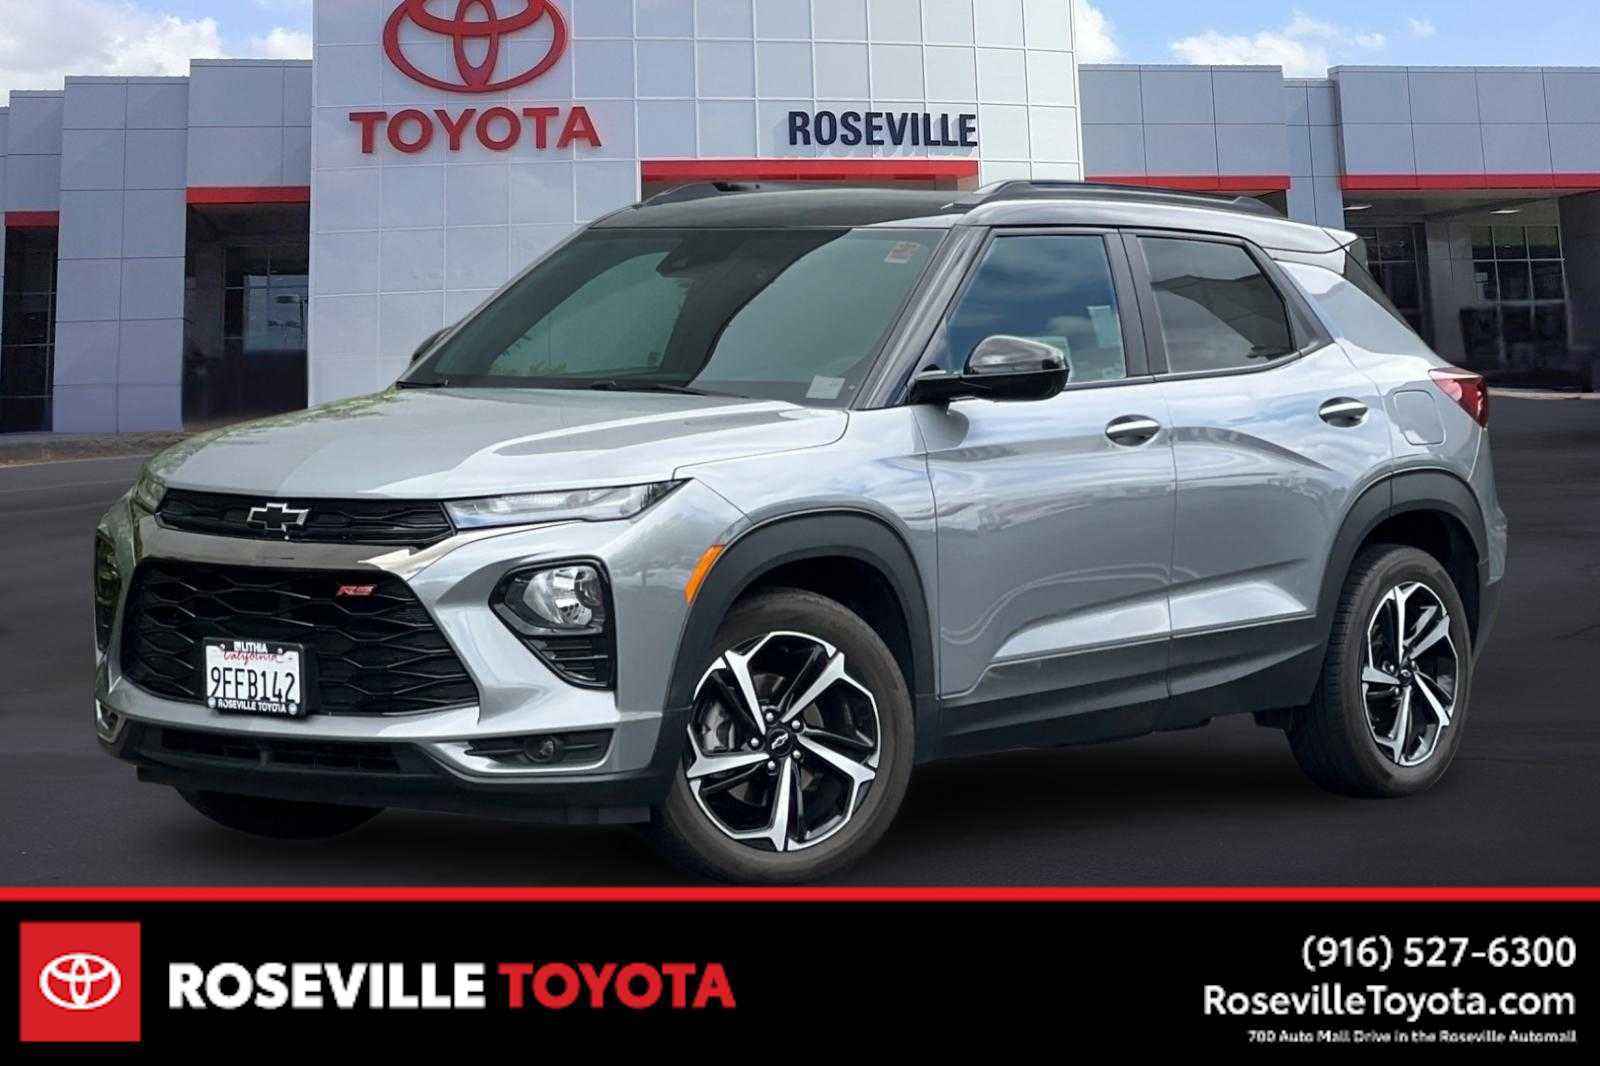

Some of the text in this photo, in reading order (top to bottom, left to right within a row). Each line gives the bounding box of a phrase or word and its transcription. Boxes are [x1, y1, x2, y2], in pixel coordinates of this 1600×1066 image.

[350, 106, 602, 153] TOYOTA
[789, 112, 978, 147] ROSEVILLE
[211, 667, 295, 703] 9FFB142
[217, 698, 287, 713] ROSEVILLE TOYOTA
